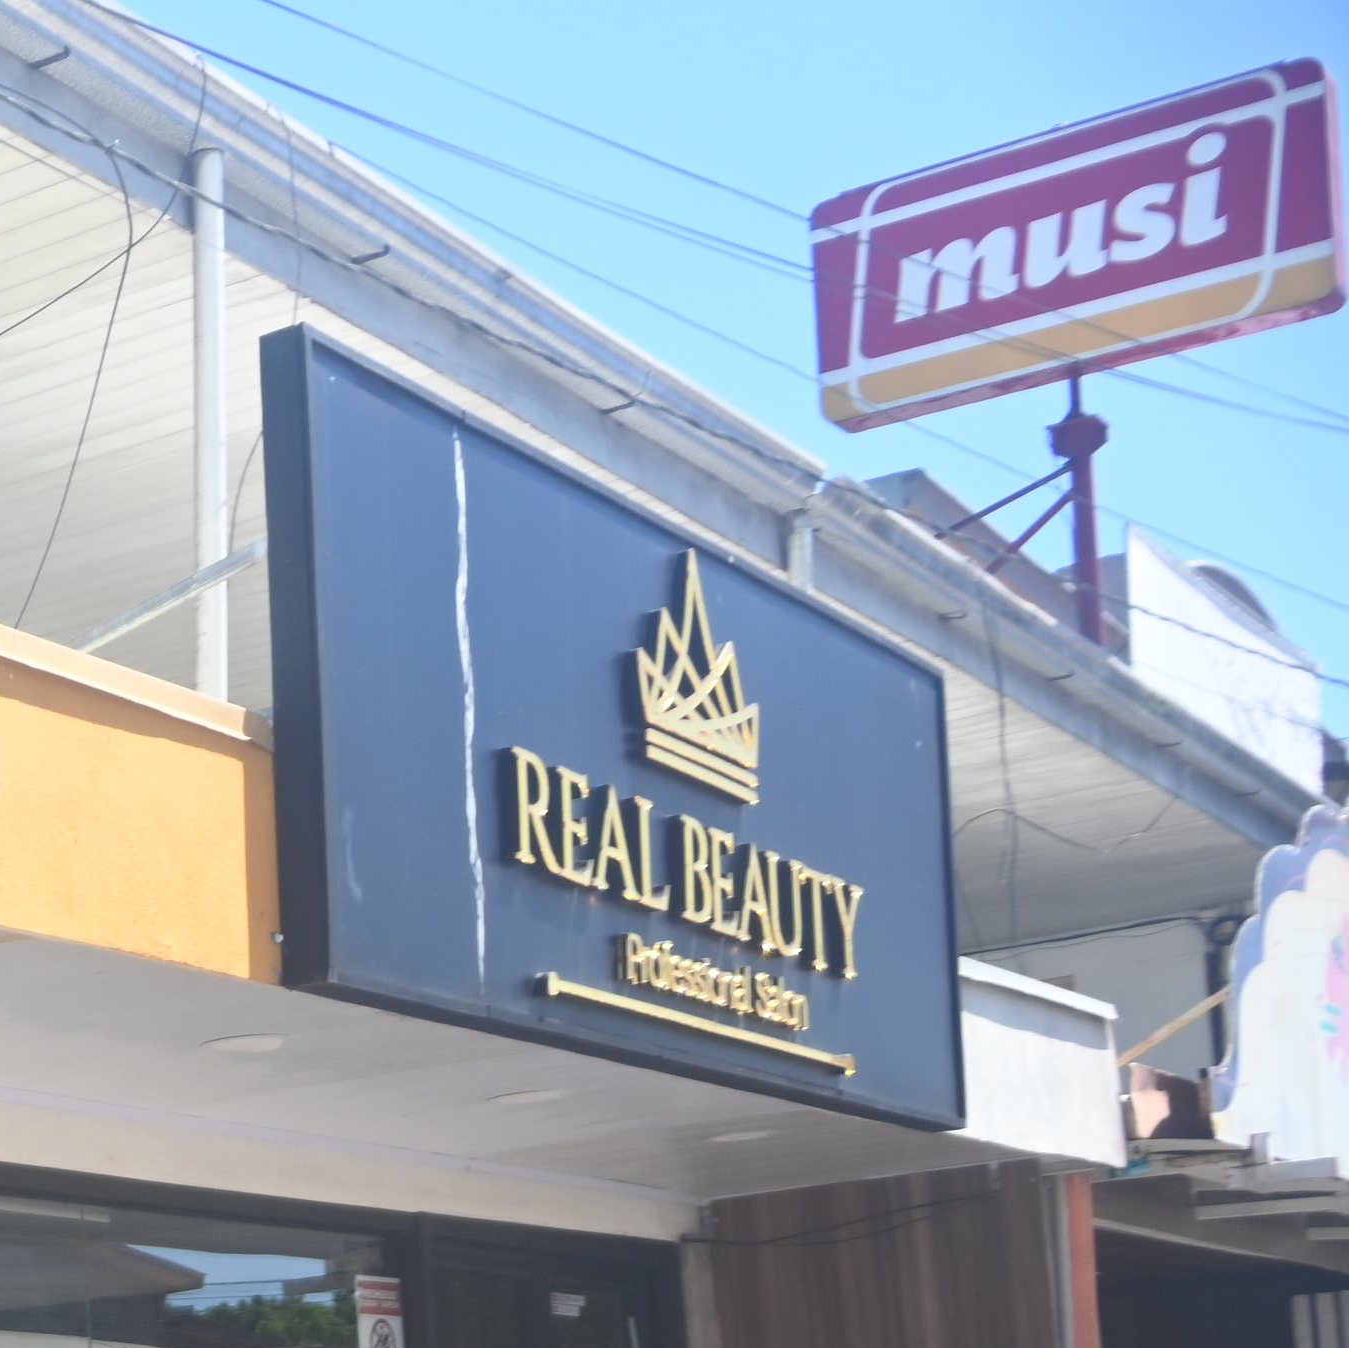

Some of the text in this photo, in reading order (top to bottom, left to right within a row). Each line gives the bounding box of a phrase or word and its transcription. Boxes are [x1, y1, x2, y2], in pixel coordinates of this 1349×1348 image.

[893, 131, 1229, 324] musi
[506, 745, 864, 979] REAL BEAUTY
